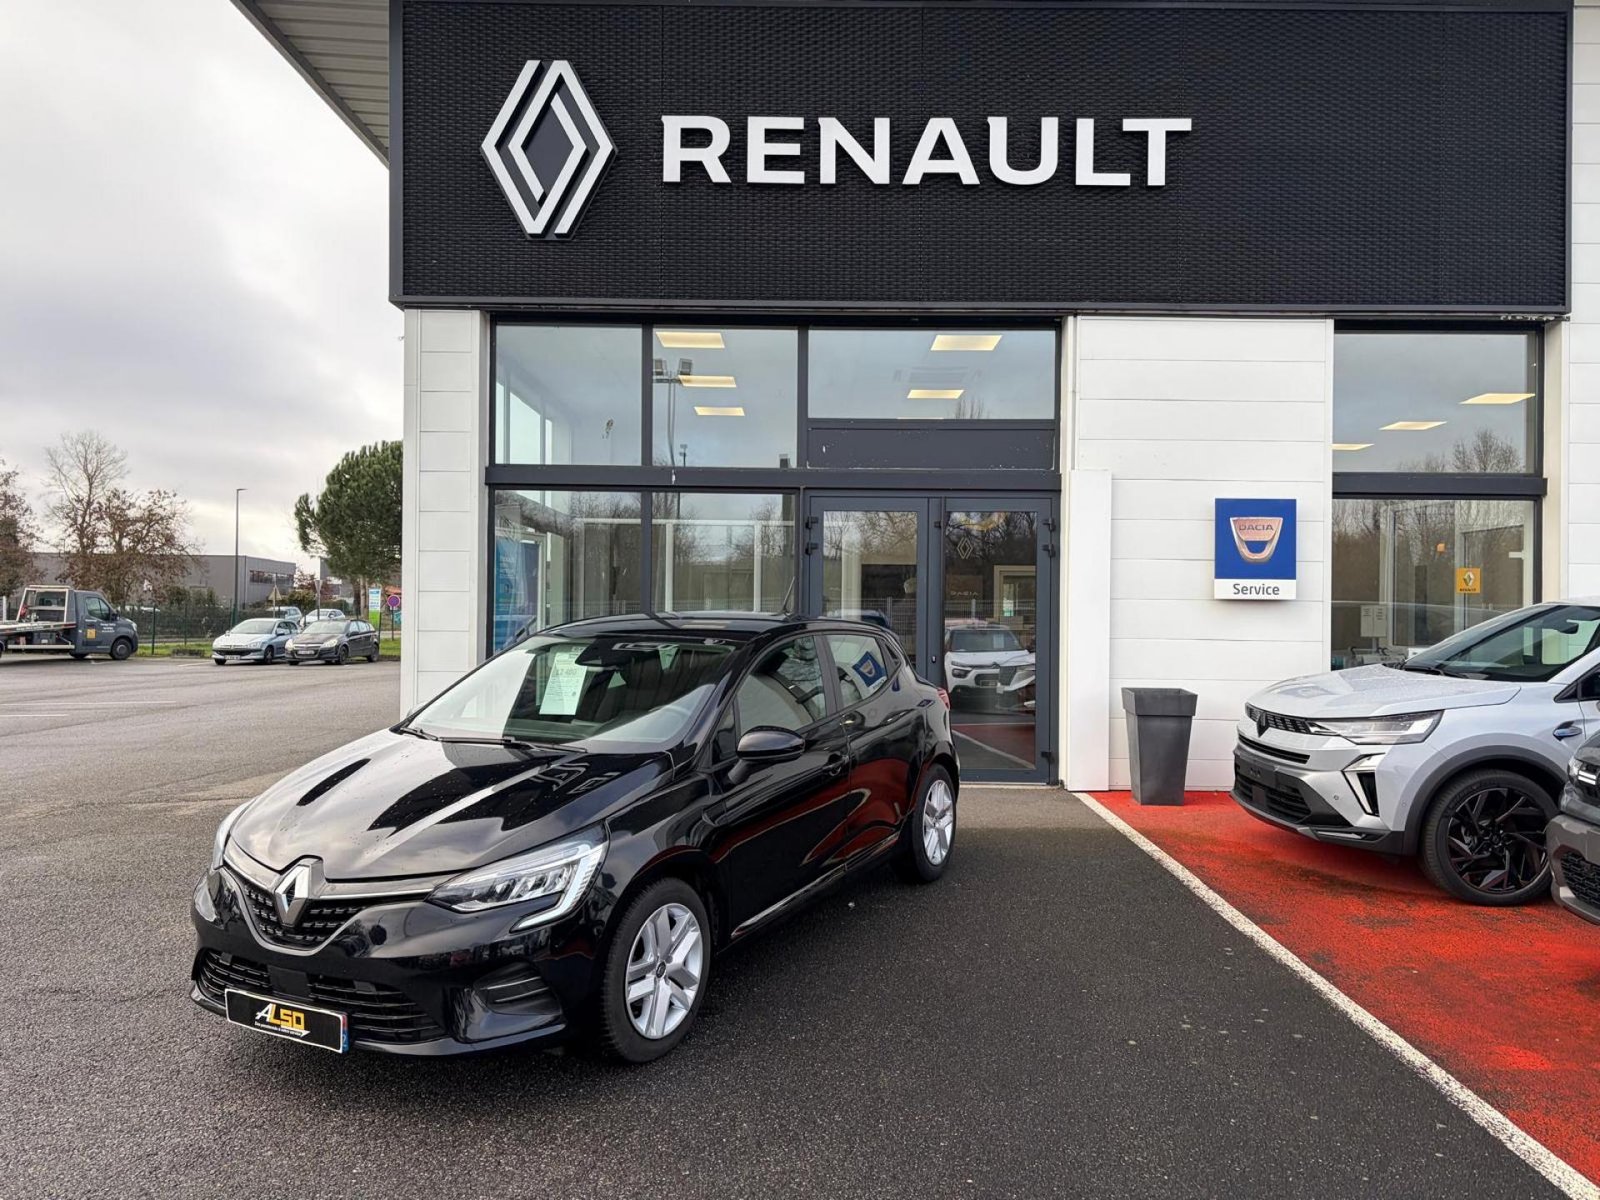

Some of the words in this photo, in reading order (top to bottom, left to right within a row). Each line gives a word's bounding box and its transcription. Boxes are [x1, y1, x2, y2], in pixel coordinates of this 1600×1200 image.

[661, 115, 1192, 186] RENAULT
[1233, 583, 1280, 596] Service
[255, 1003, 305, 1030] ALSO
